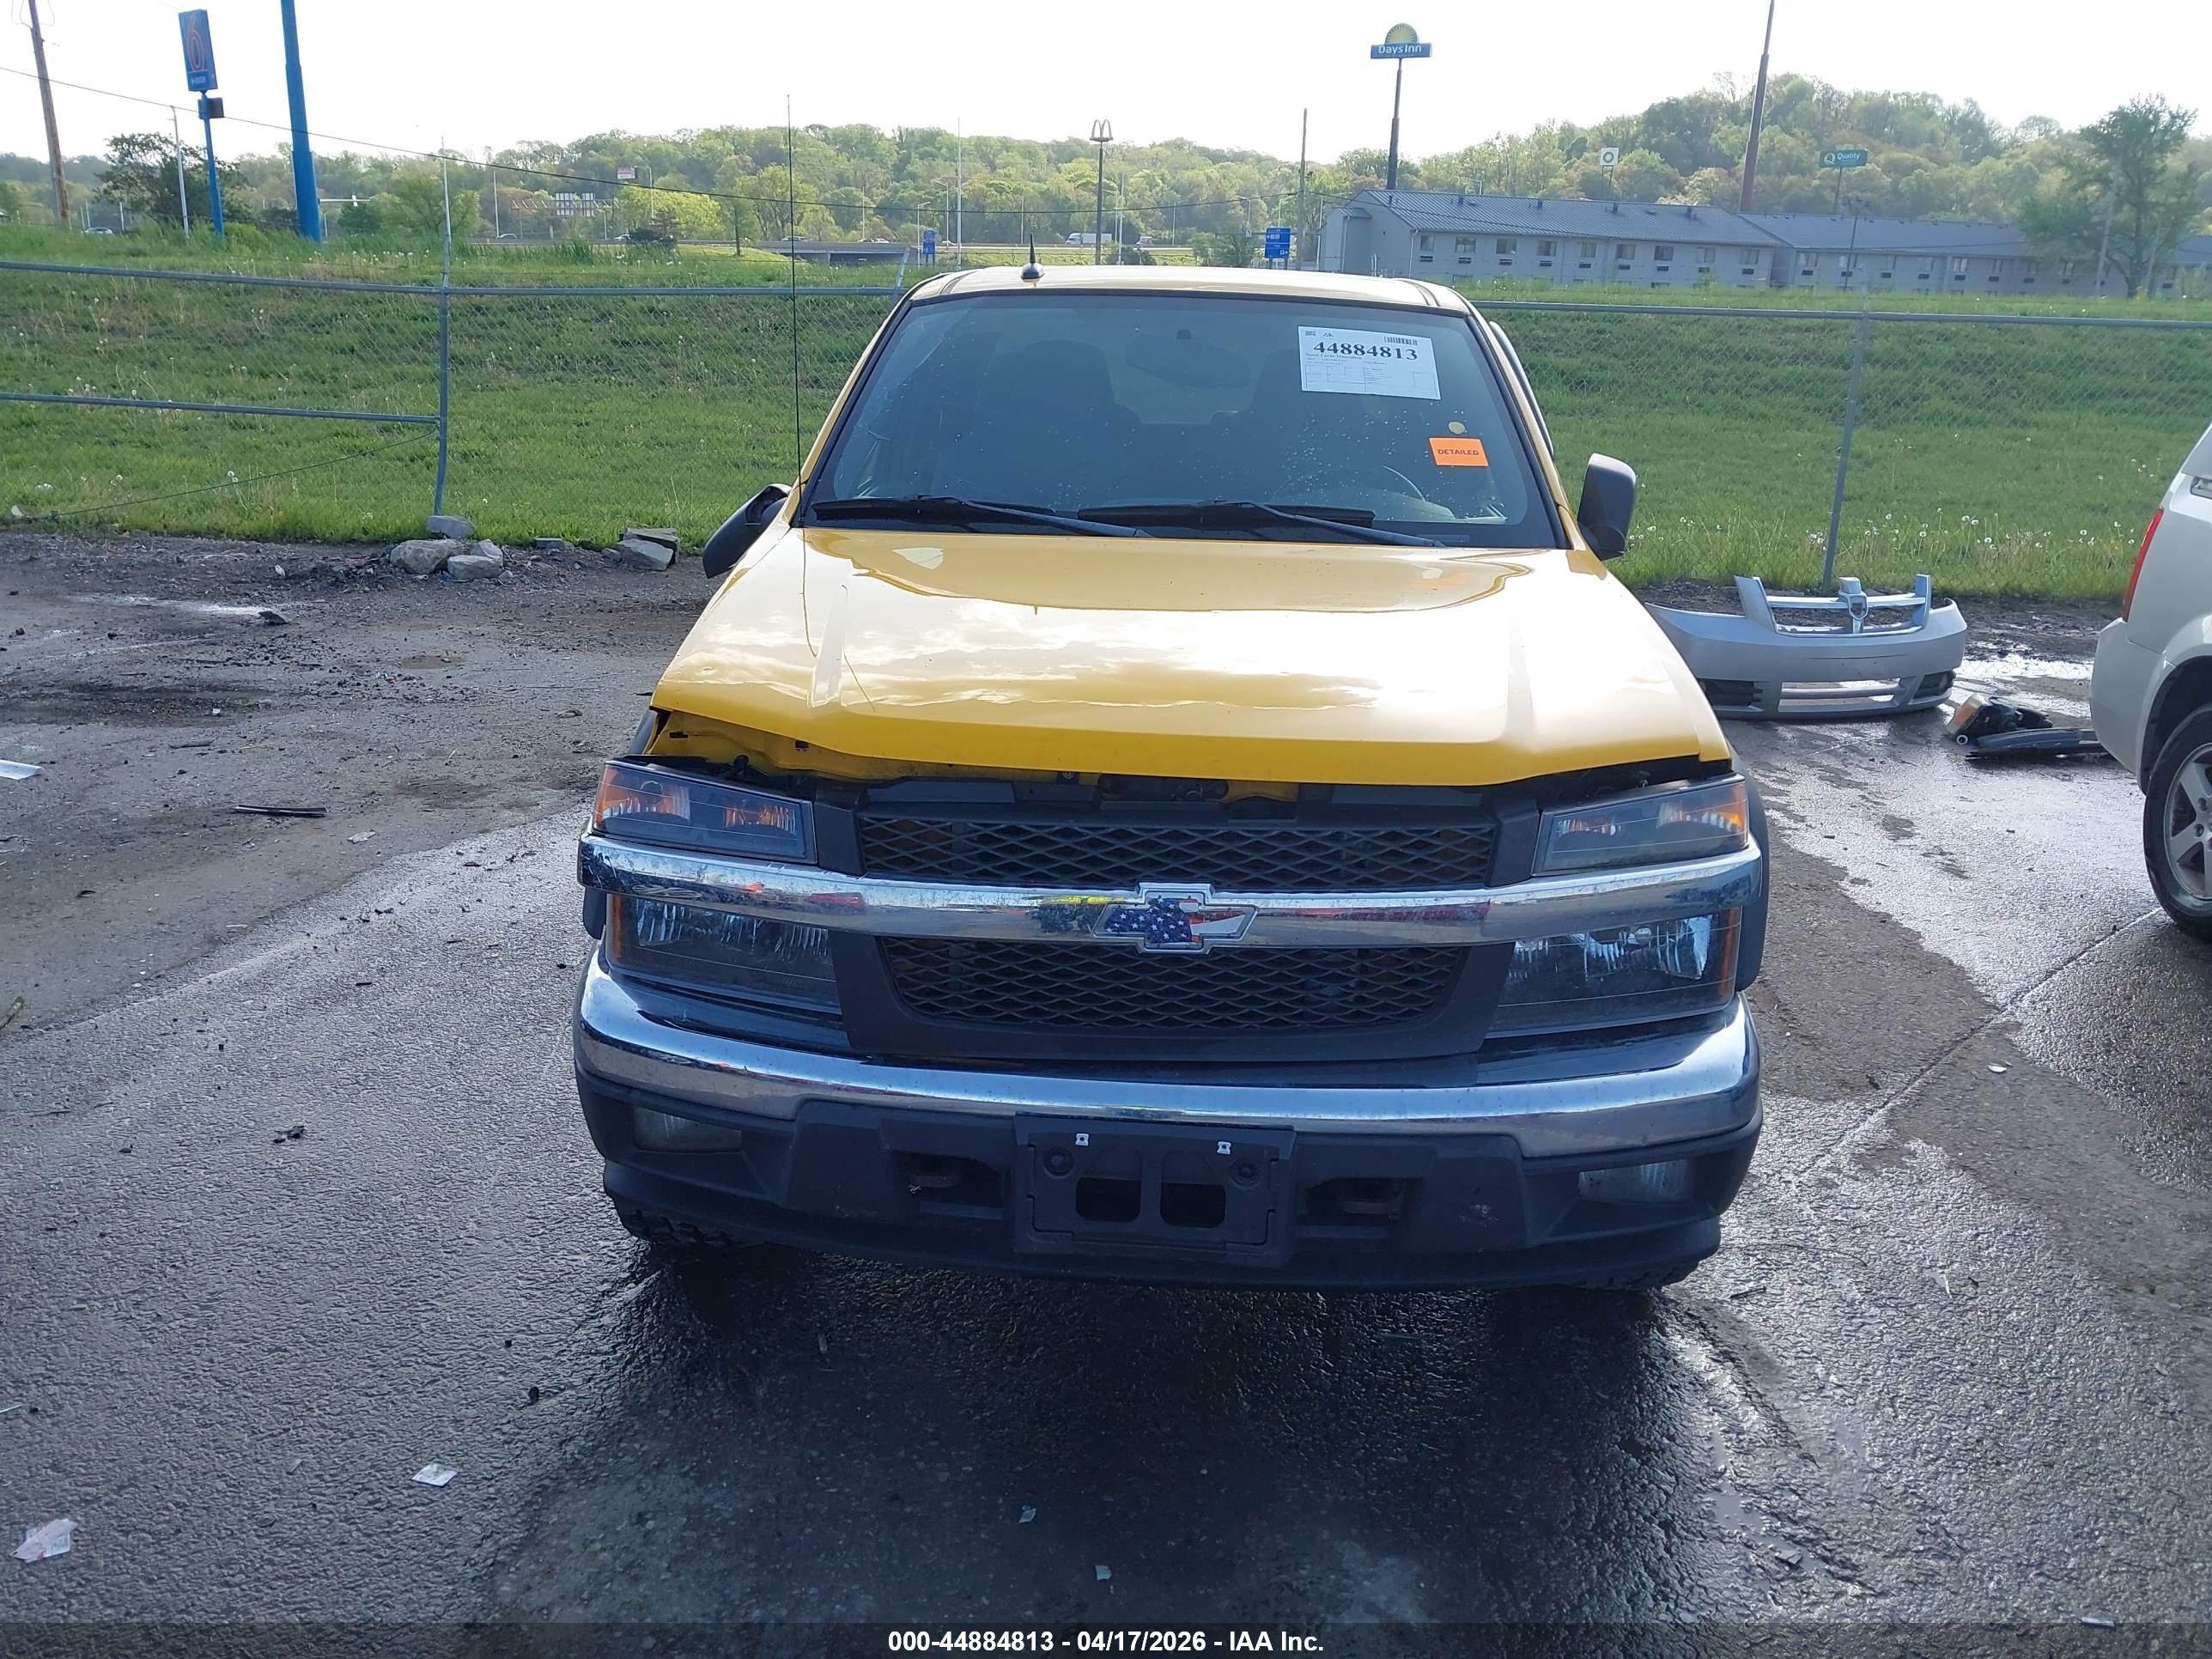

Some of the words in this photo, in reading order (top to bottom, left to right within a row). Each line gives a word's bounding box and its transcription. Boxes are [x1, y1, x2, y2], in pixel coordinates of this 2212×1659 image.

[186, 13, 205, 71] 6
[1378, 46, 1403, 54] Days
[1404, 44, 1422, 52] Inn
[1837, 152, 1861, 161] Quality
[1313, 341, 1418, 361] 44884813
